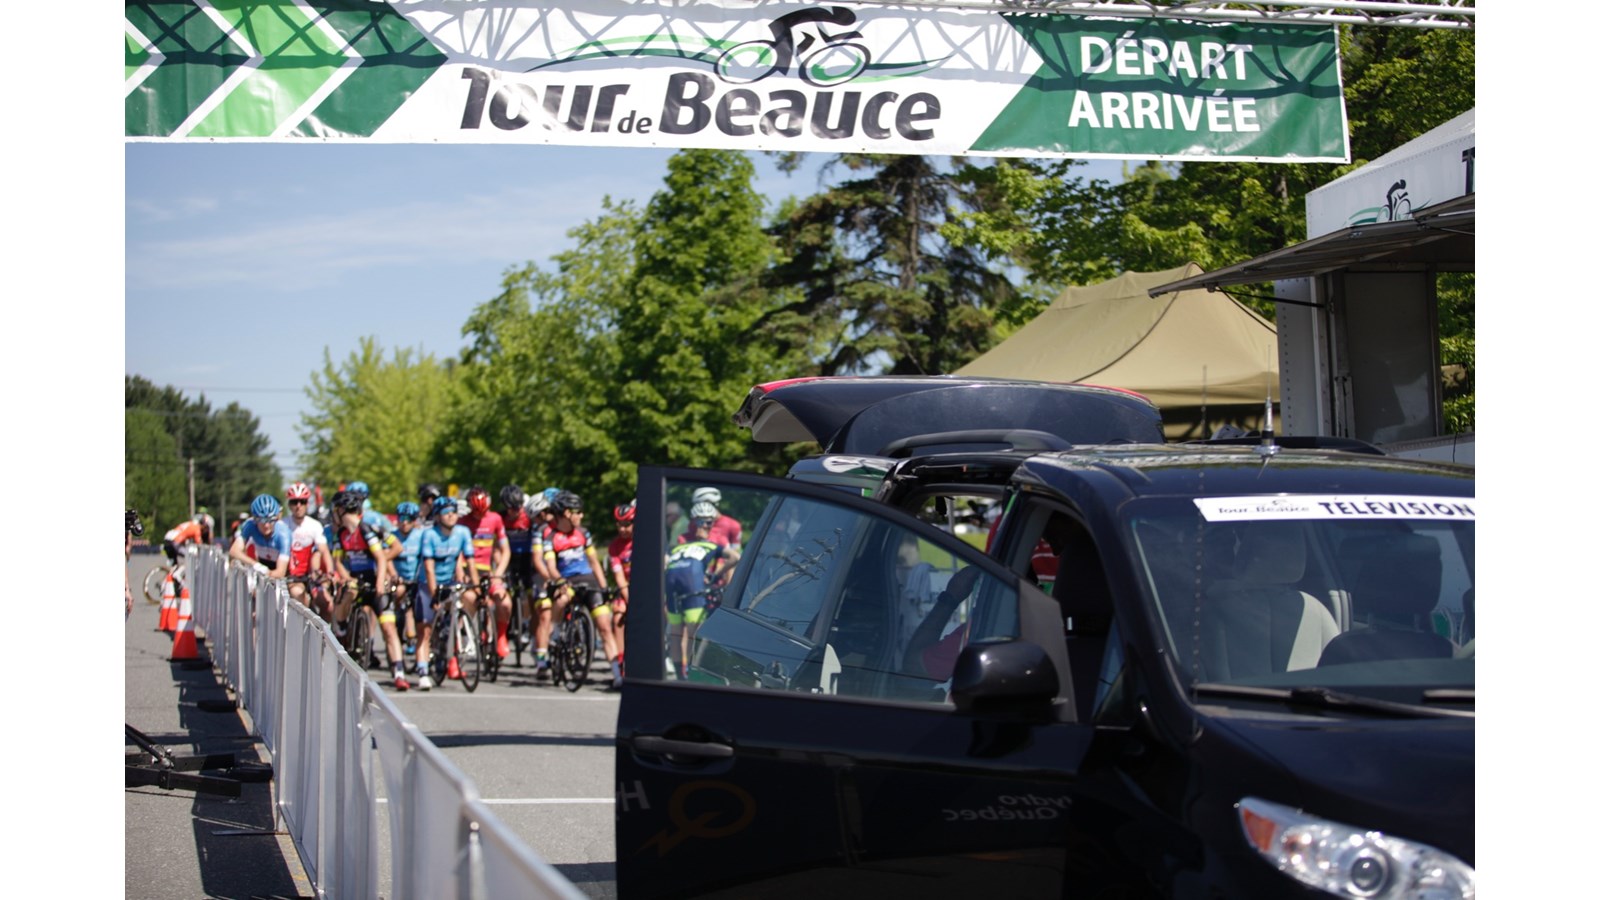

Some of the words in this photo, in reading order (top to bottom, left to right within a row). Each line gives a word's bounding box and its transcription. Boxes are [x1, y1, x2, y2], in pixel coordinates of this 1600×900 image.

[1079, 30, 1253, 81] DÉPART
[459, 67, 629, 133] Tour
[617, 109, 652, 135] de
[658, 72, 942, 141] Beauce
[1067, 88, 1261, 133] ARRIVÉE
[1317, 496, 1475, 517] TÉLÉVISION
